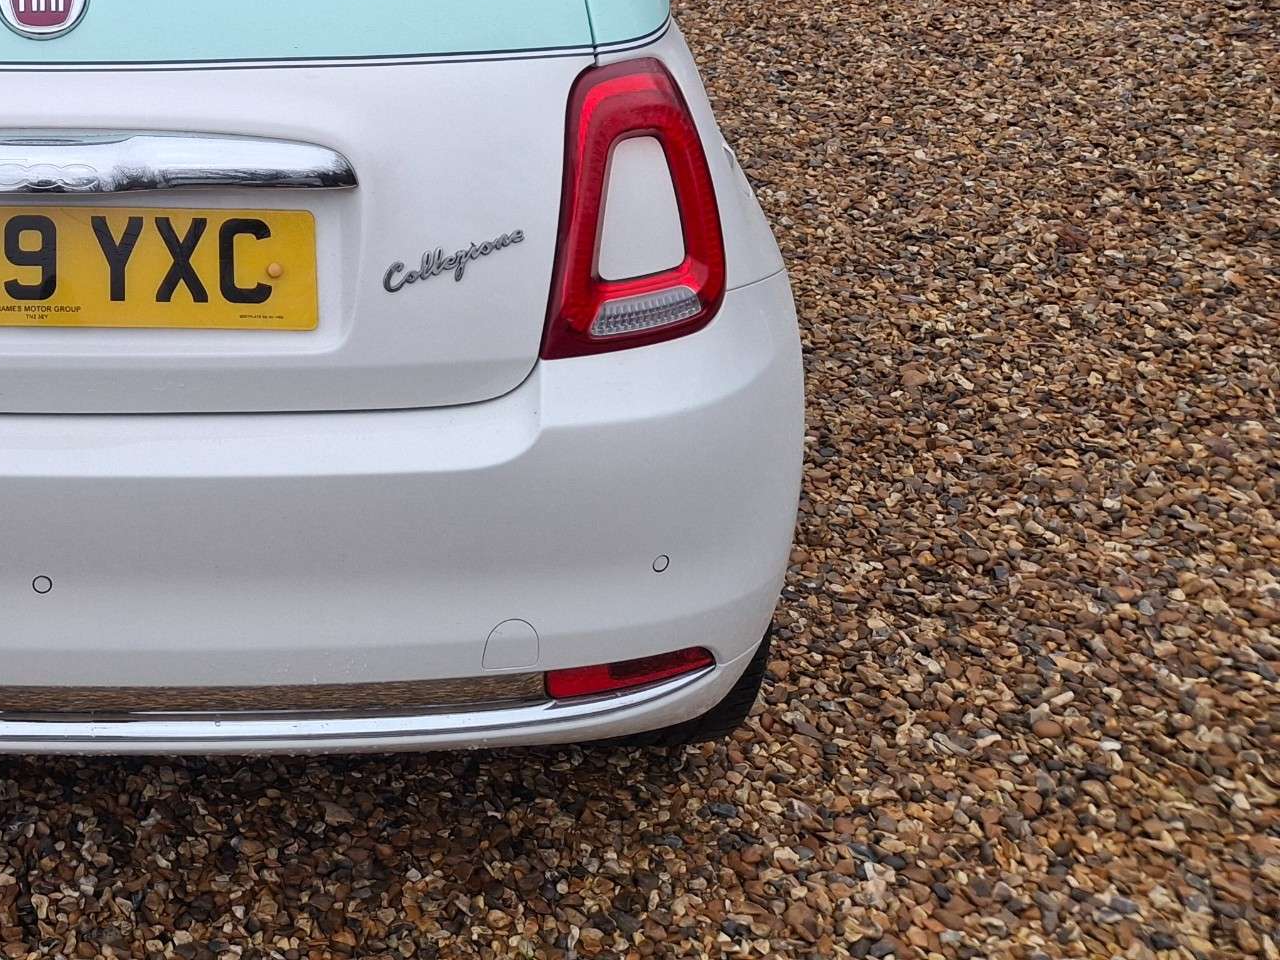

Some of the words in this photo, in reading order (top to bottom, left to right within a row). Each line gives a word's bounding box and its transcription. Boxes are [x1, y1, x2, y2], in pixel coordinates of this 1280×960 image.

[90, 216, 273, 304] YXC
[23, 305, 52, 313] MOTOR
[54, 305, 81, 313] GROUP
